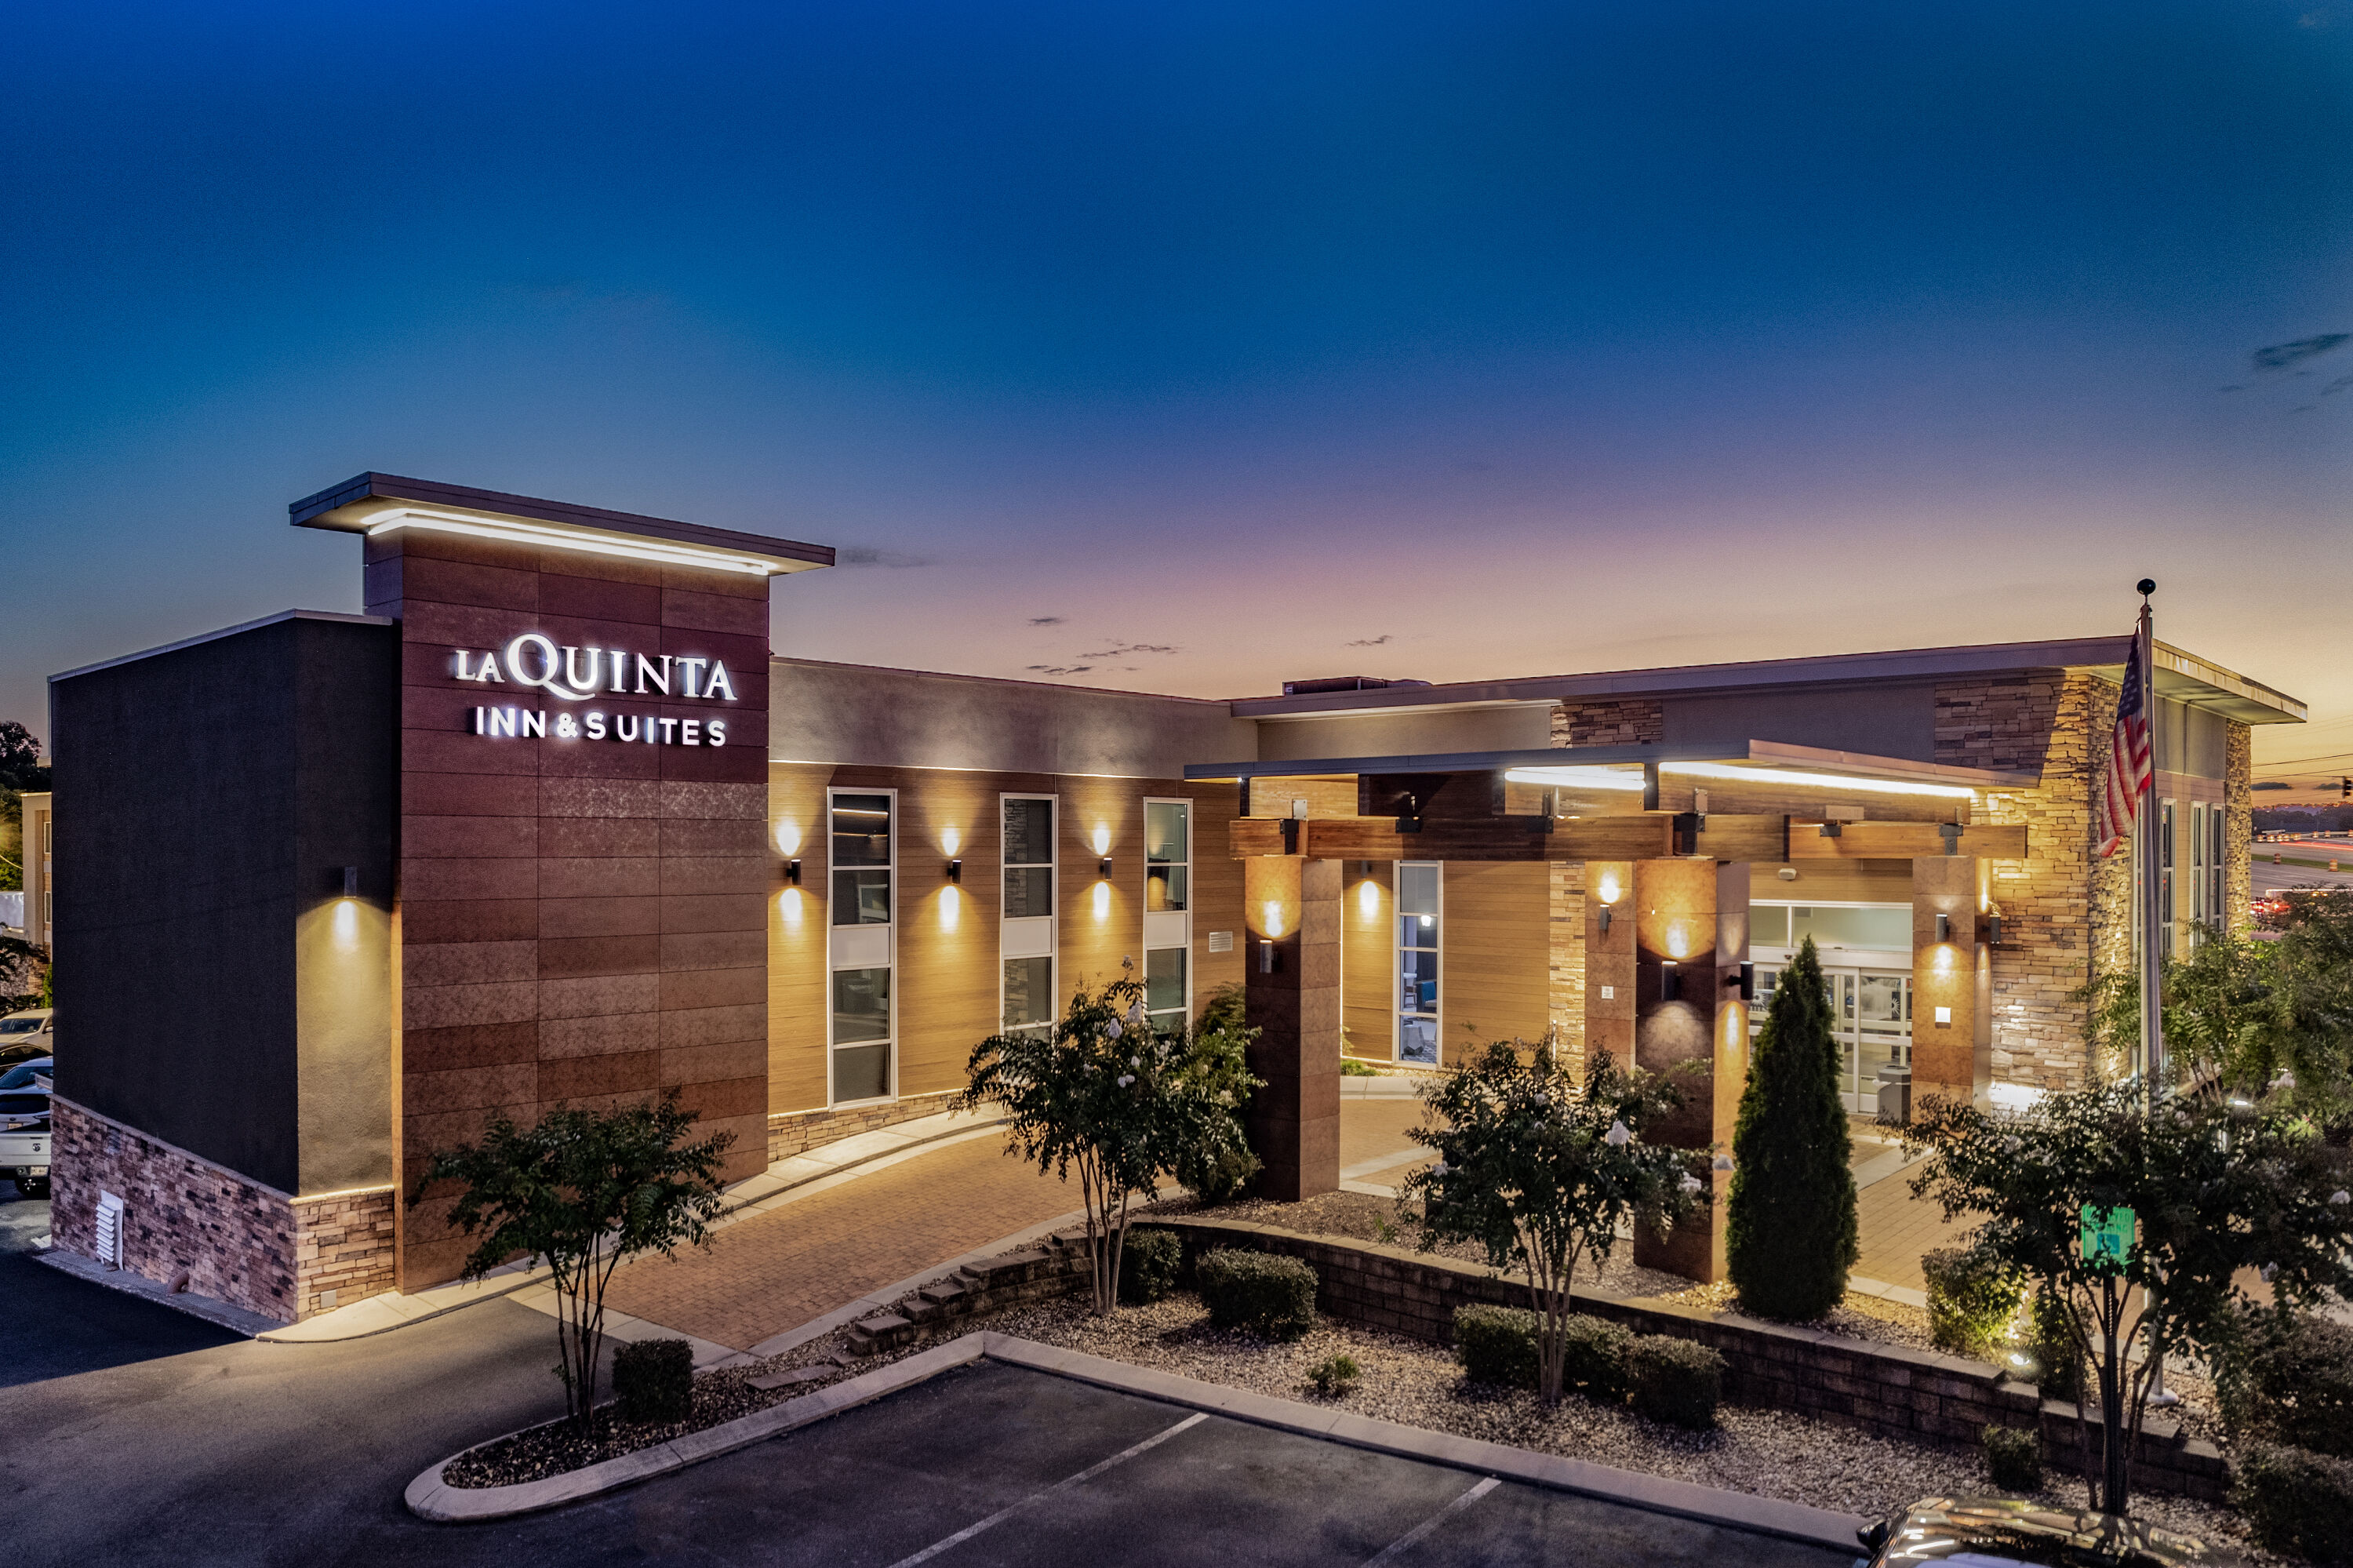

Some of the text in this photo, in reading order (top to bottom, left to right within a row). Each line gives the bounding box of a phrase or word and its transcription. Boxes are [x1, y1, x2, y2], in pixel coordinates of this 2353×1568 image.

[455, 633, 739, 701] LA QUINTA
[476, 706, 546, 739] INN
[586, 711, 726, 747] SUITES
